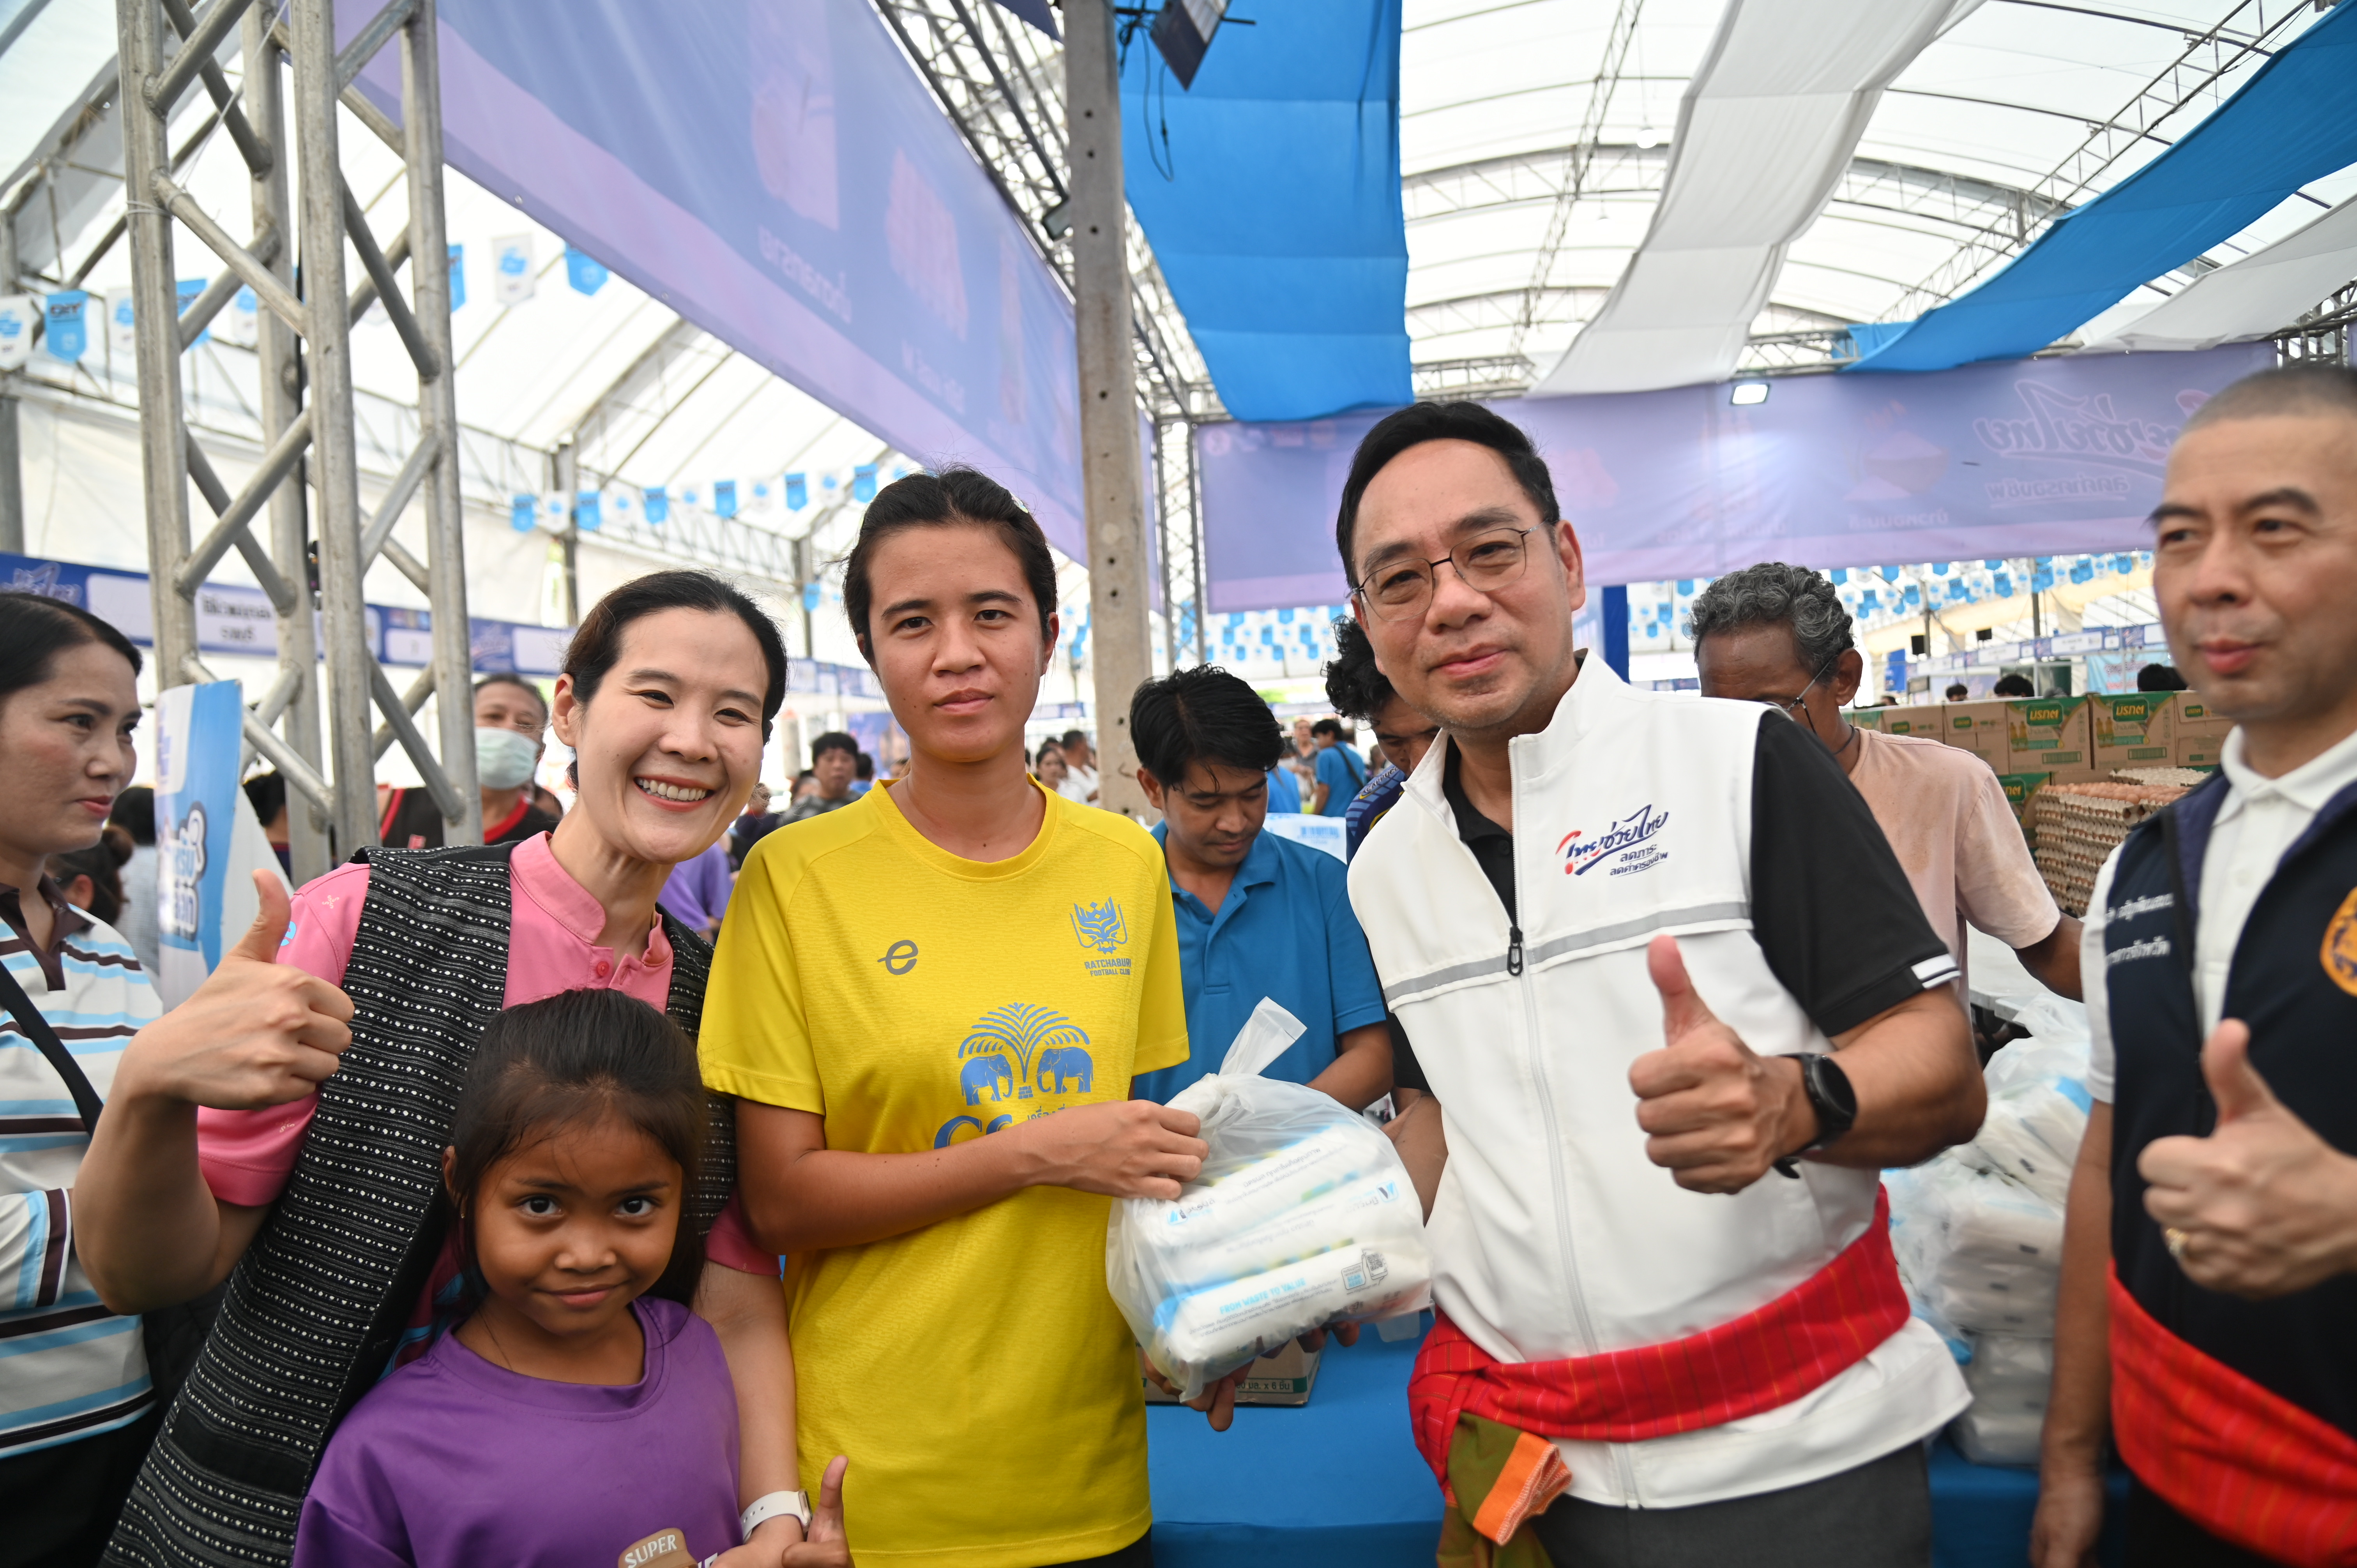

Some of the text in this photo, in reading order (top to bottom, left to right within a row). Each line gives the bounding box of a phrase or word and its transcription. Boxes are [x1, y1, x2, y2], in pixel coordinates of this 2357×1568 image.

[2030, 709, 2059, 720] มรกต
[2117, 705, 2145, 716] มรกต
[1620, 844, 1657, 862] ลดภาระ
[1610, 851, 1668, 876] ลดค่าครองชีพ
[1084, 958, 1131, 969] RATCHABURI
[1220, 1301, 1242, 1314] FROM
[1243, 1291, 1269, 1307] WASTE
[1270, 1287, 1281, 1296] TO
[1281, 1278, 1306, 1292] VALUE
[1279, 1380, 1290, 1390] ชิ้น
[625, 1534, 677, 1568] SUPER
